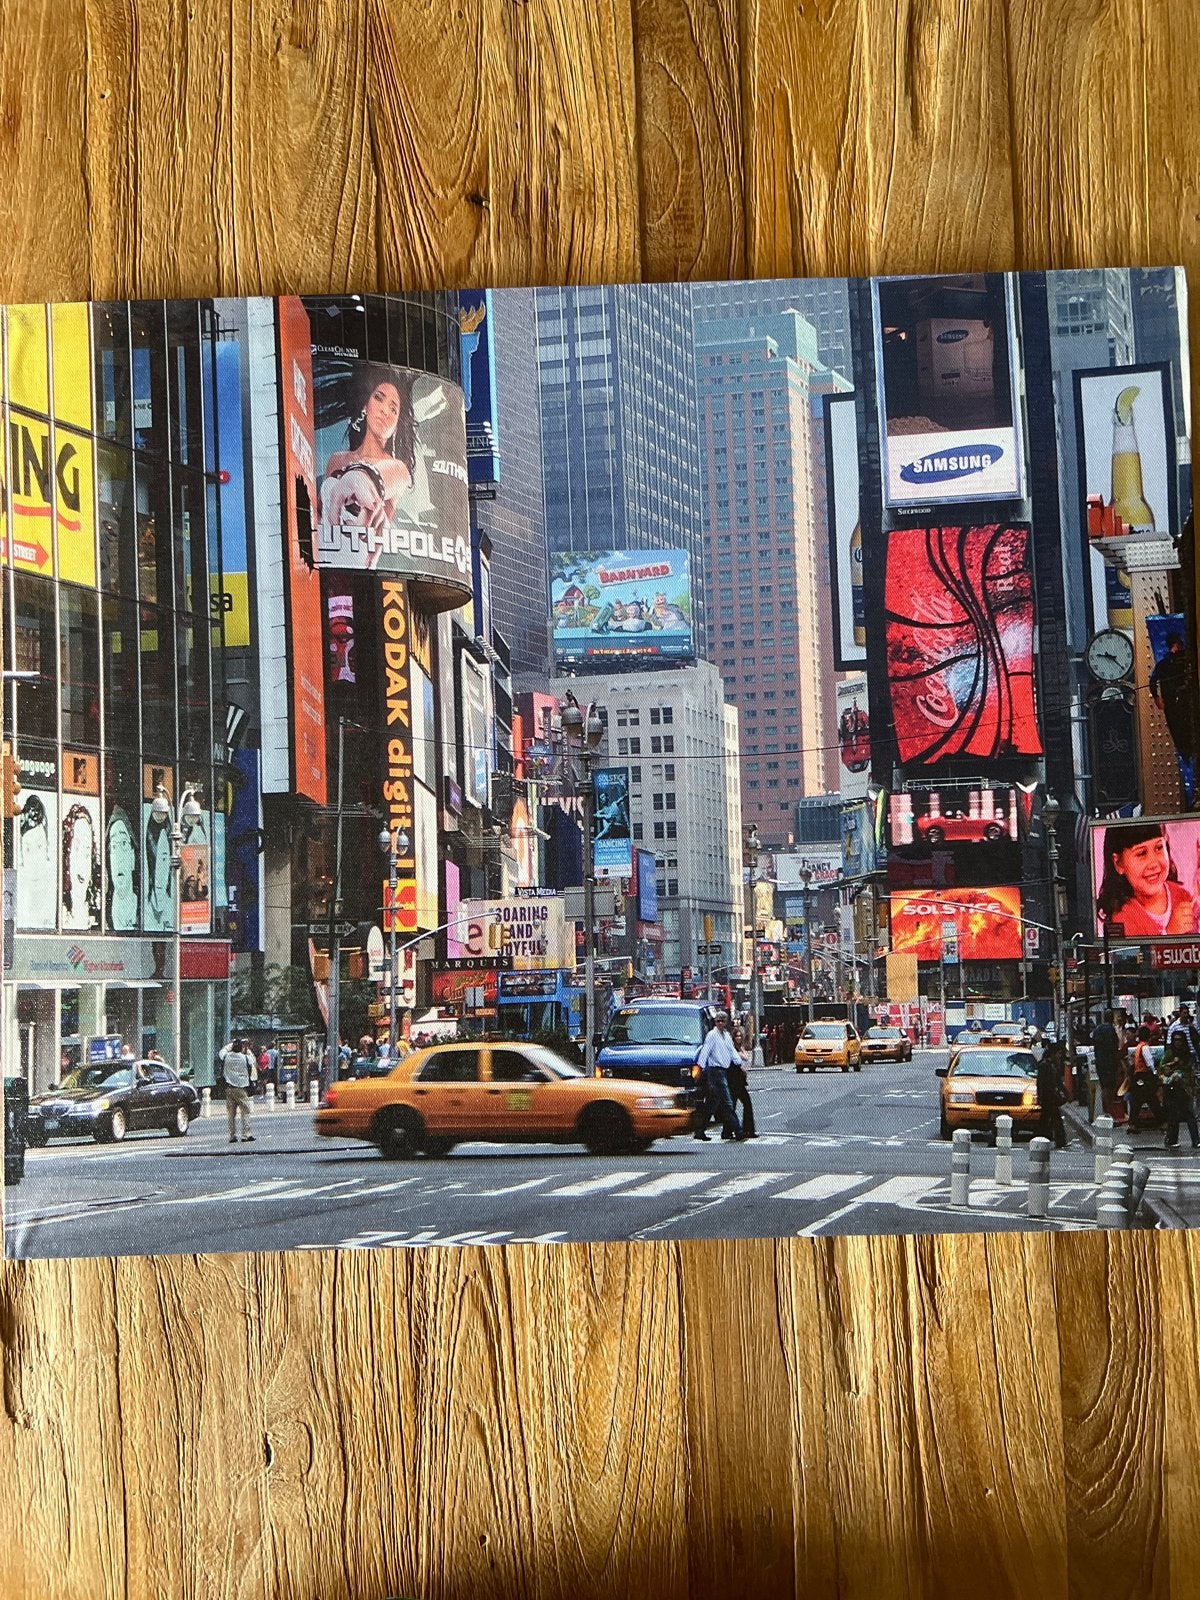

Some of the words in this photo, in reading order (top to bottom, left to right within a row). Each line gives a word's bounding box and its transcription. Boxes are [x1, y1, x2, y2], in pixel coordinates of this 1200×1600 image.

[3, 422, 81, 513] ING
[912, 453, 993, 474] SAMSUNG
[317, 524, 456, 563] UTHPOLE
[600, 564, 671, 584] BARNYARD
[381, 581, 410, 728] KODAK
[537, 887, 557, 896] MEDIA
[509, 923, 533, 939] AND
[431, 959, 509, 969] MARQUIS
[1163, 944, 1200, 964] swat
